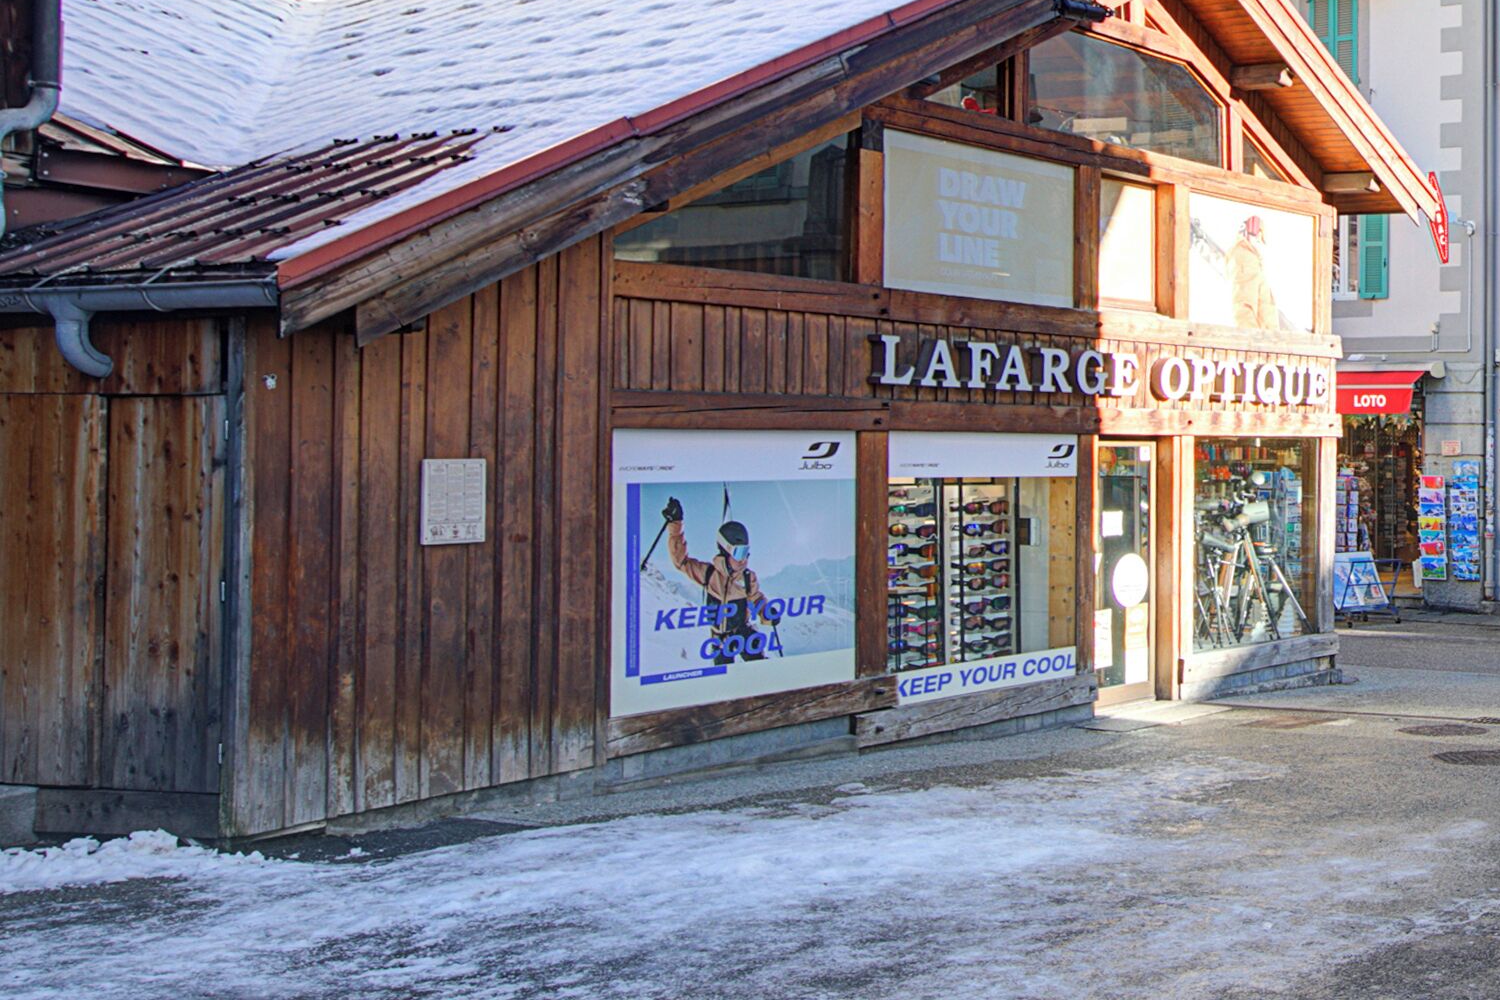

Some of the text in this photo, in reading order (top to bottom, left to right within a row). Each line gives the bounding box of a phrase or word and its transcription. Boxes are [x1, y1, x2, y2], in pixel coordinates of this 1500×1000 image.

[939, 167, 1028, 209] DRAW
[937, 200, 1019, 239] YOUR
[938, 232, 1000, 268] LINE
[874, 334, 1329, 405] LAFARGE OPTIQUE
[1353, 394, 1387, 407] LOTO
[654, 595, 826, 631] KEEP YOUR
[699, 631, 784, 660] COOL
[898, 653, 1077, 697] KEEP YOUR COOL
